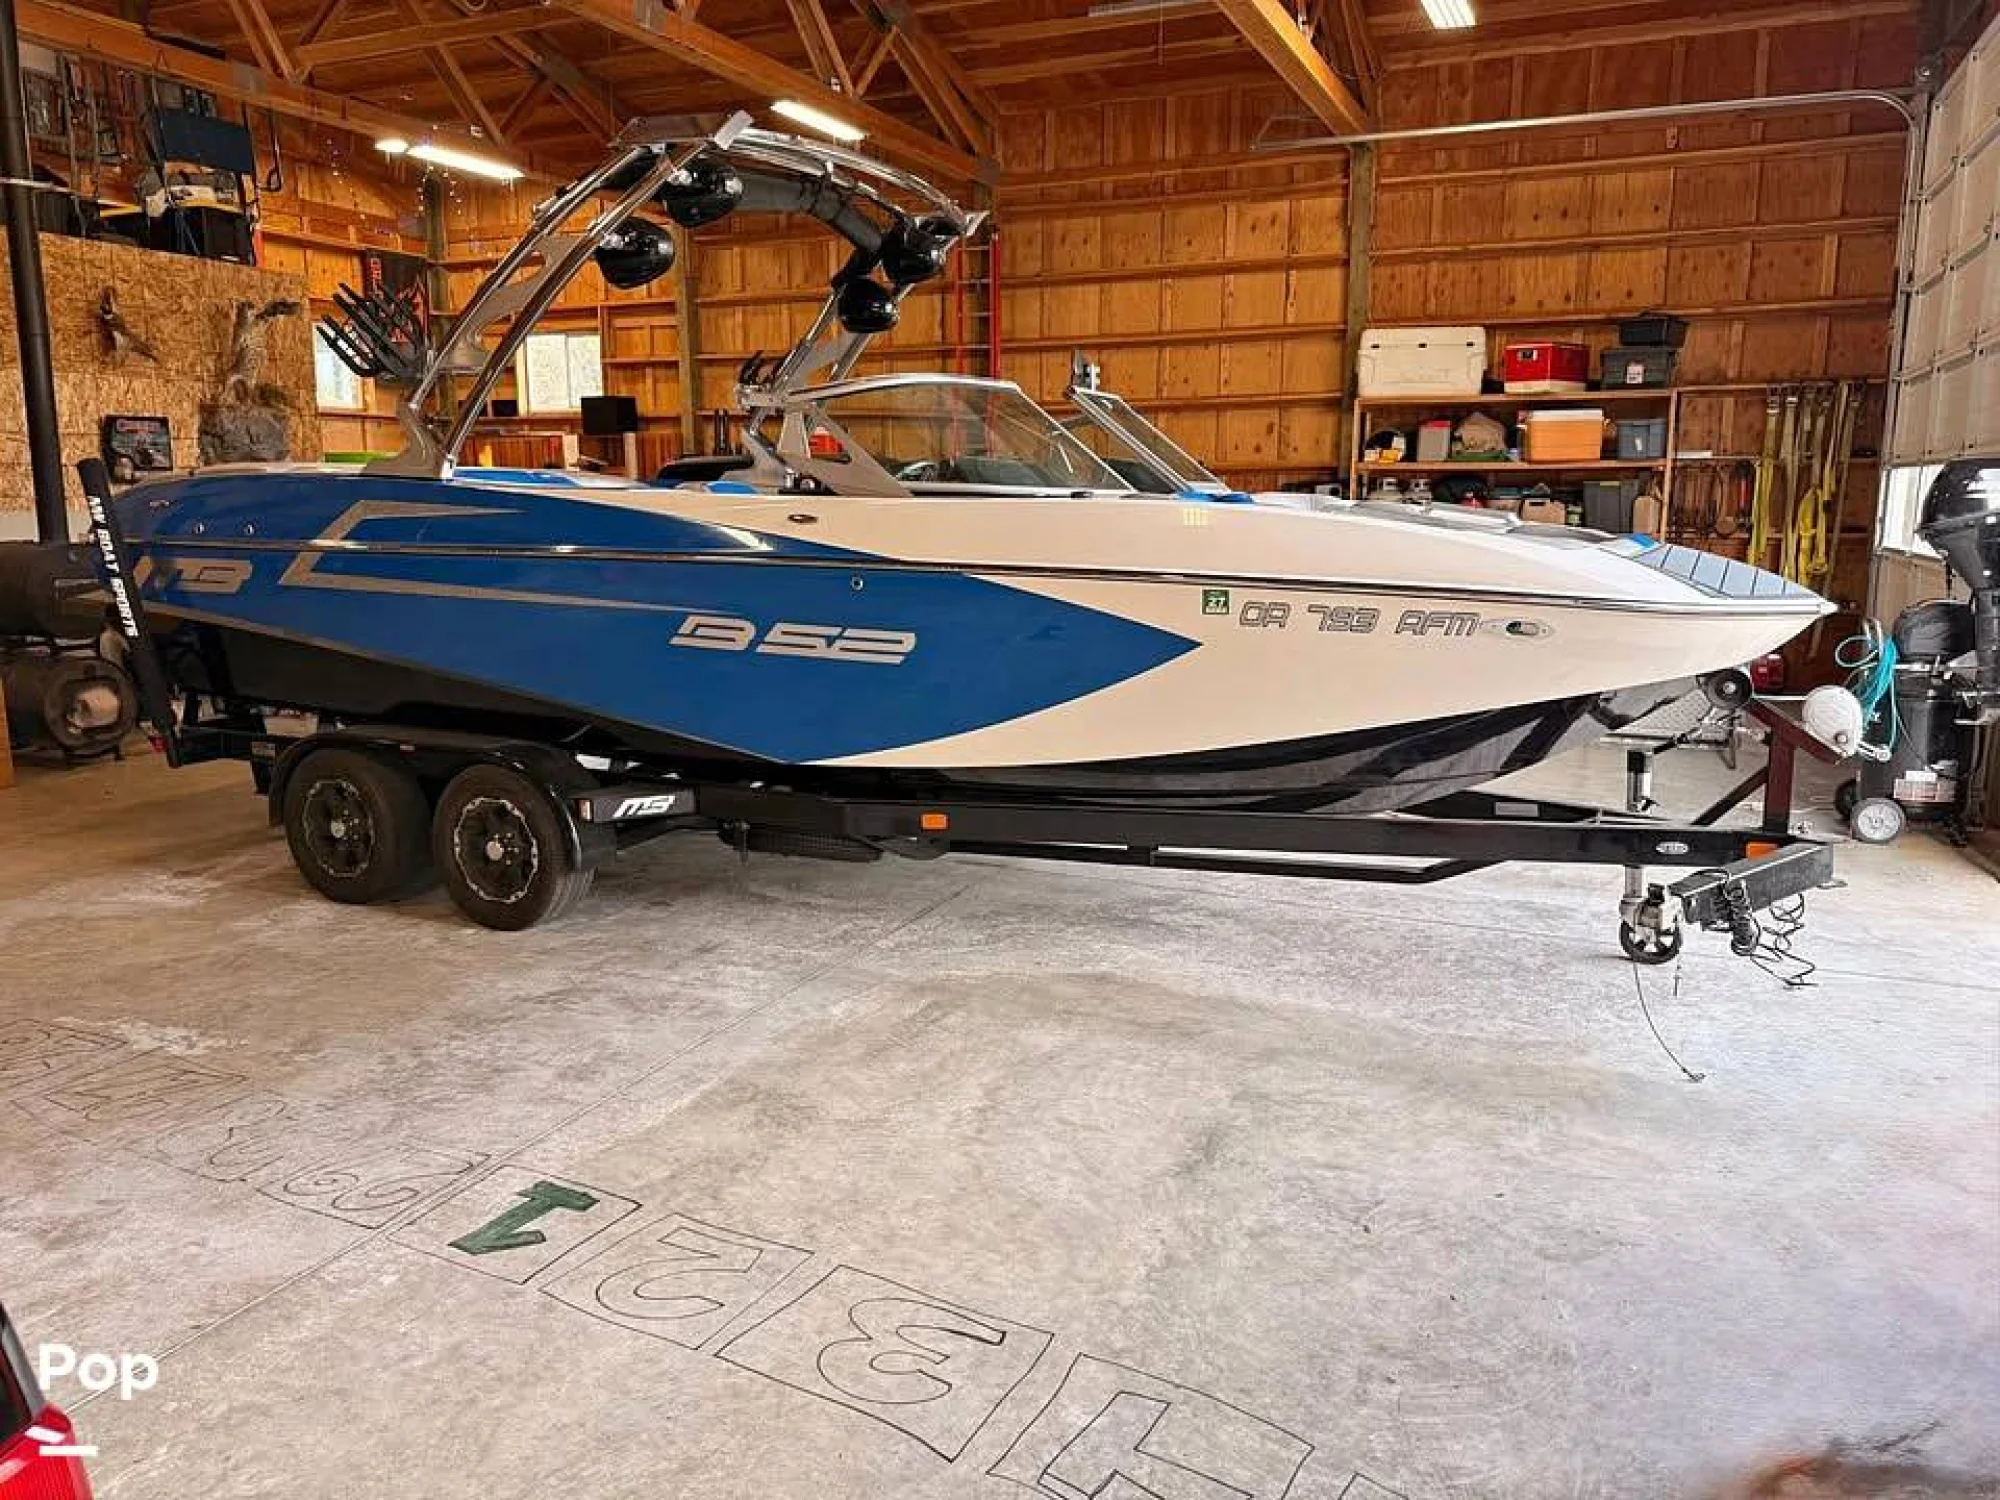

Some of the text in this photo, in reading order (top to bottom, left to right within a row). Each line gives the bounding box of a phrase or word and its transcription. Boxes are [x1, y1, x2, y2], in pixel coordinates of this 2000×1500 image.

[97, 528, 120, 572] BOAT
[110, 577, 139, 637] SPORTS
[1240, 601, 1290, 627] OR
[447, 1178, 602, 1255] 1
[595, 1225, 763, 1320] 2
[816, 1297, 1007, 1405] 3
